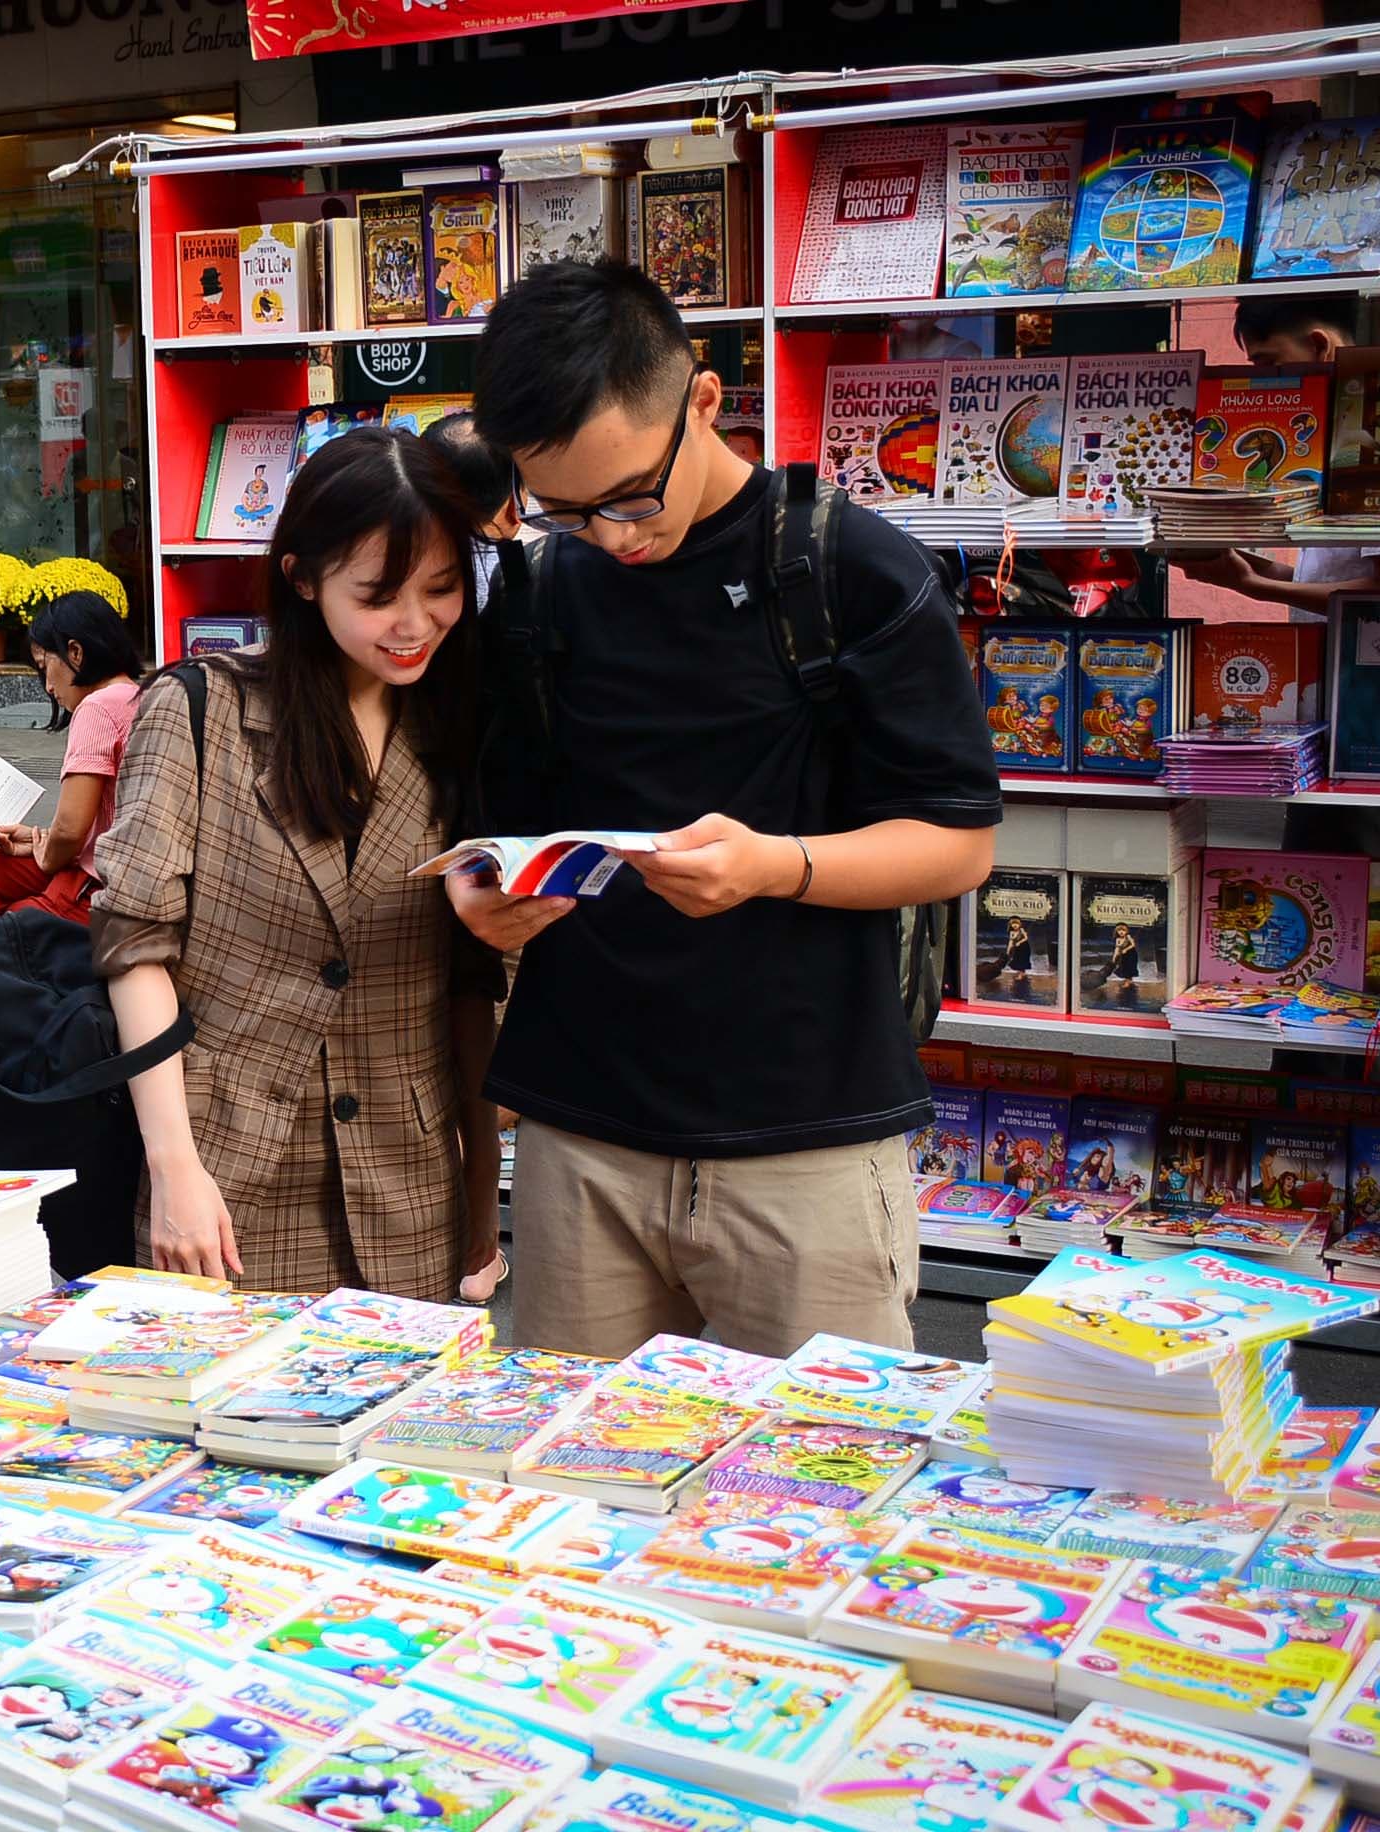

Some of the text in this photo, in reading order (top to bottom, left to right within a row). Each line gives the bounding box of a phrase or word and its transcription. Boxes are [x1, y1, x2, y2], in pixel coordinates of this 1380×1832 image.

[114, 22, 174, 62] Hand
[879, 175, 916, 197] KHOA
[959, 184, 999, 200] CHO
[1042, 184, 1070, 196] EM
[182, 244, 239, 262] REMARQUE
[270, 276, 285, 286] NAM
[371, 343, 411, 357] BODY
[372, 358, 411, 372] SHOP
[833, 379, 938, 399] BÁCH KHOA
[950, 373, 1061, 394] BÁCH KHOA
[1076, 369, 1192, 391] BÁCH KHOA
[949, 395, 979, 417] ĐỊA
[1074, 389, 1175, 411] KHOA HỌC
[1220, 391, 1302, 408] KHỦNG LONG
[234, 428, 261, 441] NHẬT
[259, 441, 272, 455] VÀ
